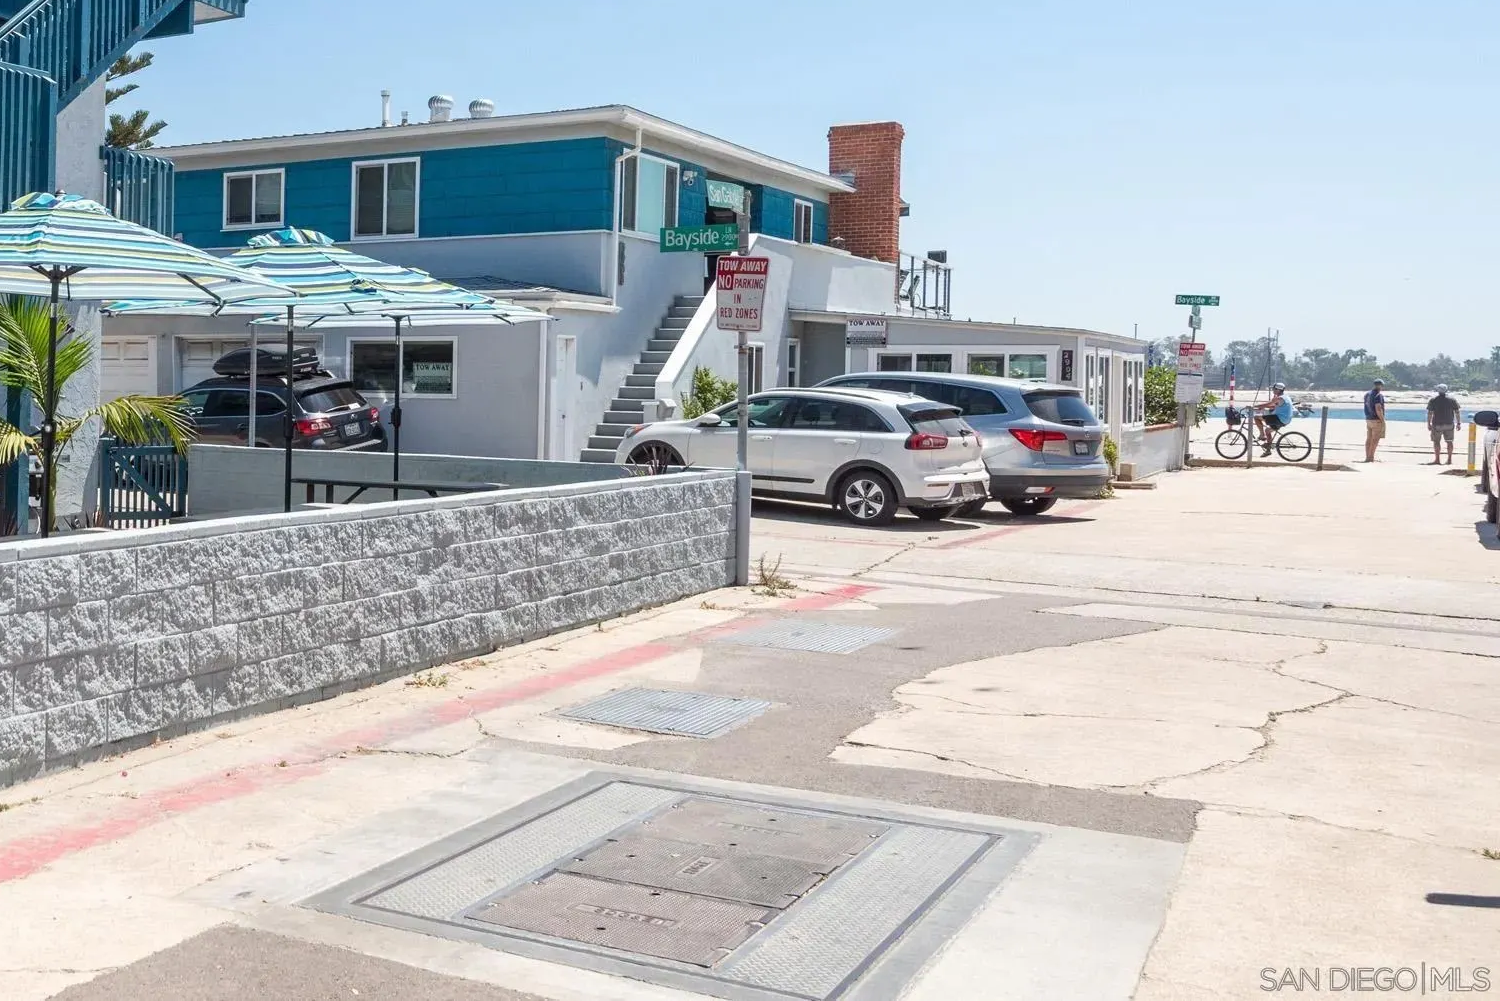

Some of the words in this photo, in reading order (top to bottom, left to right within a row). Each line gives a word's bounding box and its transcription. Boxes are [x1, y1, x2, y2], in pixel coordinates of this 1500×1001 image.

[665, 228, 720, 251] Bayside
[719, 260, 739, 271] TOW
[740, 260, 767, 272] AWAY
[718, 274, 732, 289] NO
[734, 278, 764, 289] PARKING
[733, 293, 742, 304] IN
[1176, 295, 1206, 304] Bayside
[720, 307, 733, 318] RED
[735, 307, 758, 320] ZONES
